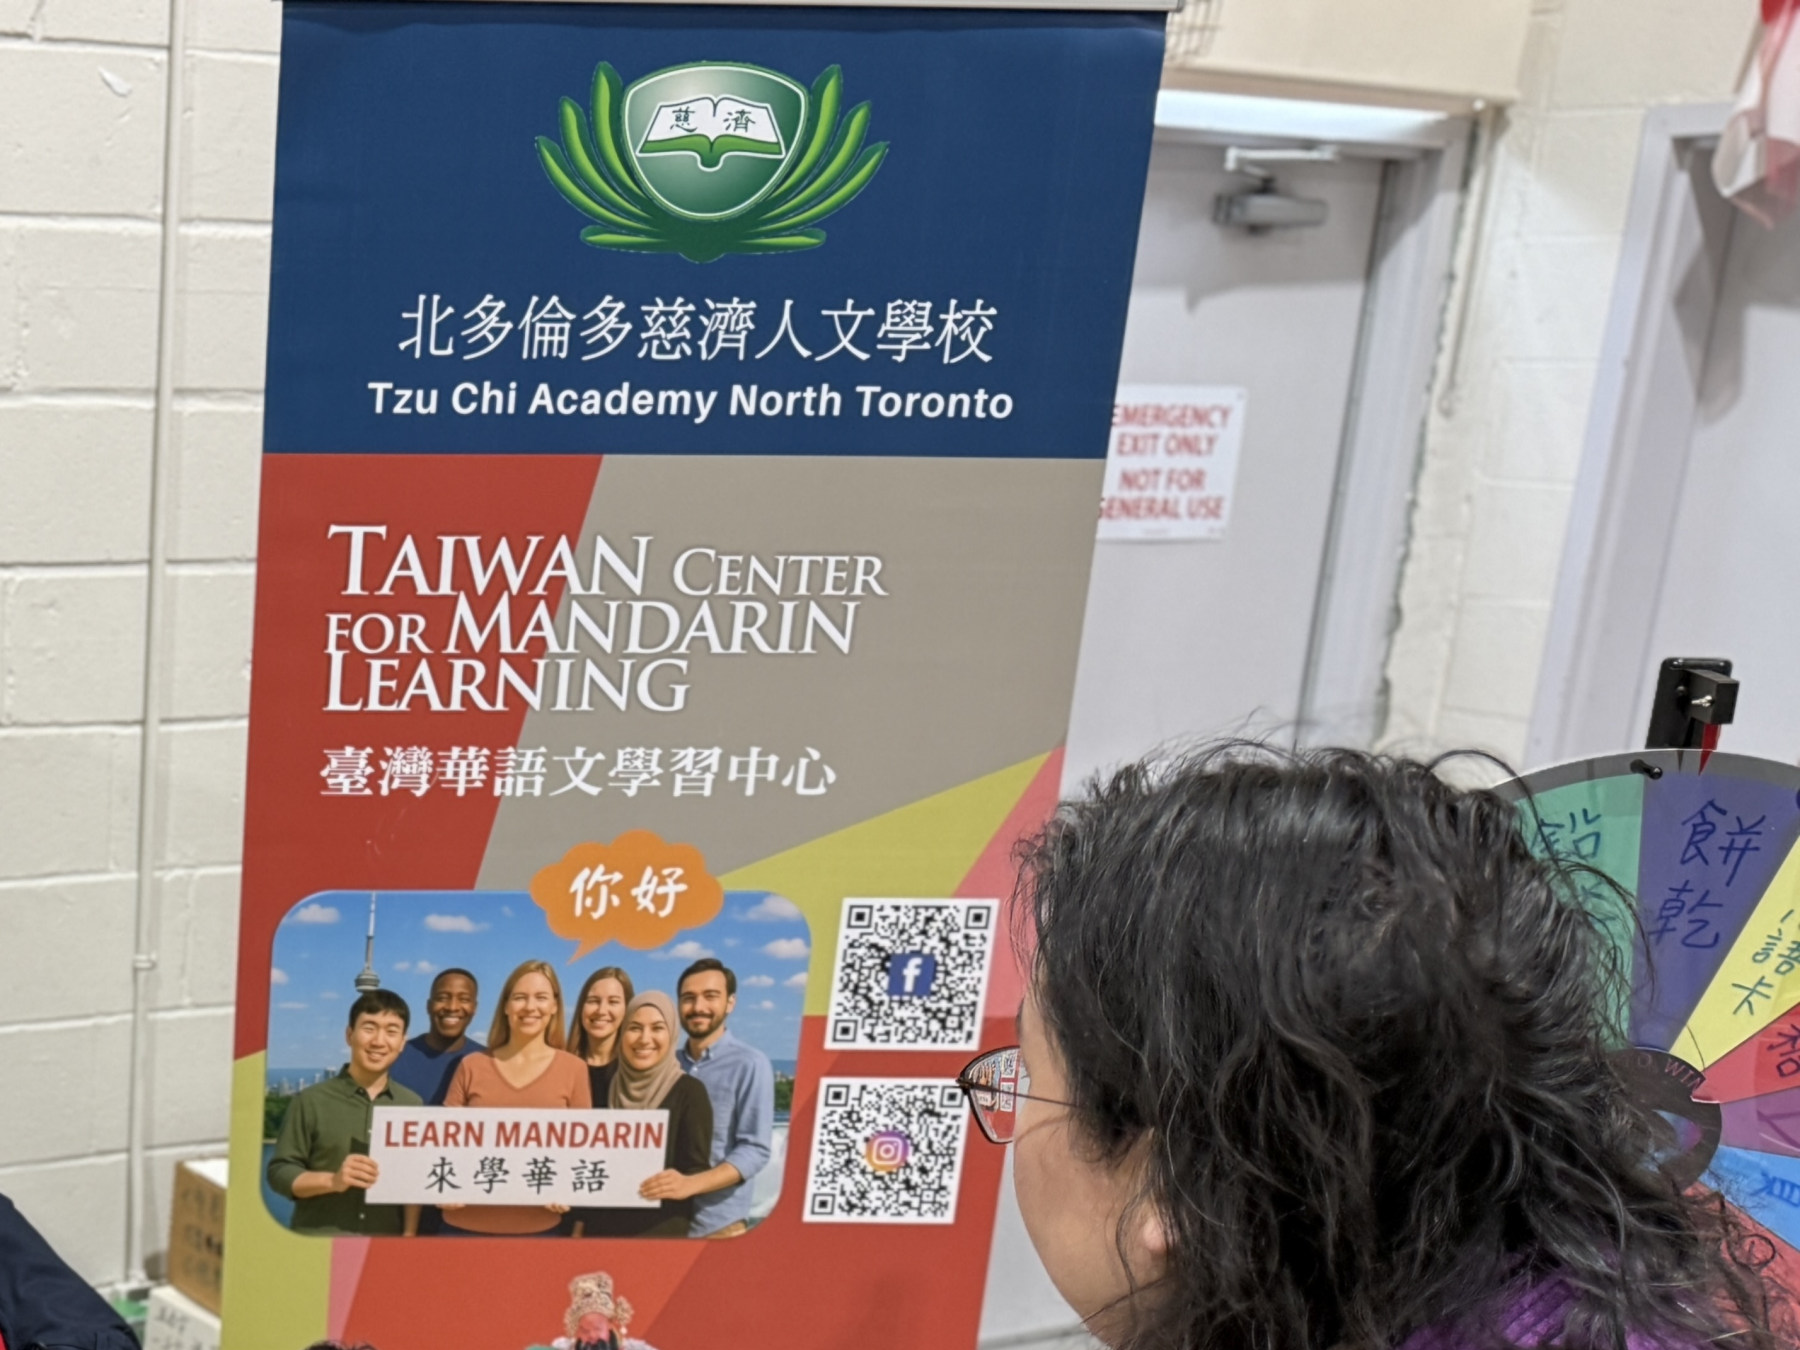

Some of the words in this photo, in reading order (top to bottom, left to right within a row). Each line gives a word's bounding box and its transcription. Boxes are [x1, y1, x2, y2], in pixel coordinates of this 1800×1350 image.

[668, 105, 758, 135] 慈濟
[397, 293, 998, 366] 北多倫多慈濟人文學校
[367, 382, 439, 416] Tzu
[451, 382, 518, 416] Chi
[529, 383, 717, 425] Academy
[728, 384, 843, 419] North
[856, 386, 1014, 420] Toronto
[1111, 404, 1232, 428] EMERGENCY
[1117, 433, 1161, 456] EXIT
[1164, 433, 1218, 456] ONLY
[1118, 468, 1161, 491] NOT
[1166, 468, 1206, 491] FOR
[1186, 496, 1224, 520] USE
[327, 524, 654, 598] TAIWAN
[673, 546, 889, 599] CENTER
[324, 613, 435, 655] FOR
[442, 590, 861, 656] MANDARIN
[323, 644, 693, 713] LEARNING
[319, 745, 838, 799] 臺灣華語文學習中心
[568, 864, 688, 921] 你好
[1649, 799, 1767, 950] 餅乾
[384, 1119, 485, 1149] LEARN
[499, 1119, 666, 1151] MANDARIN
[425, 1155, 611, 1195] 來學華語
